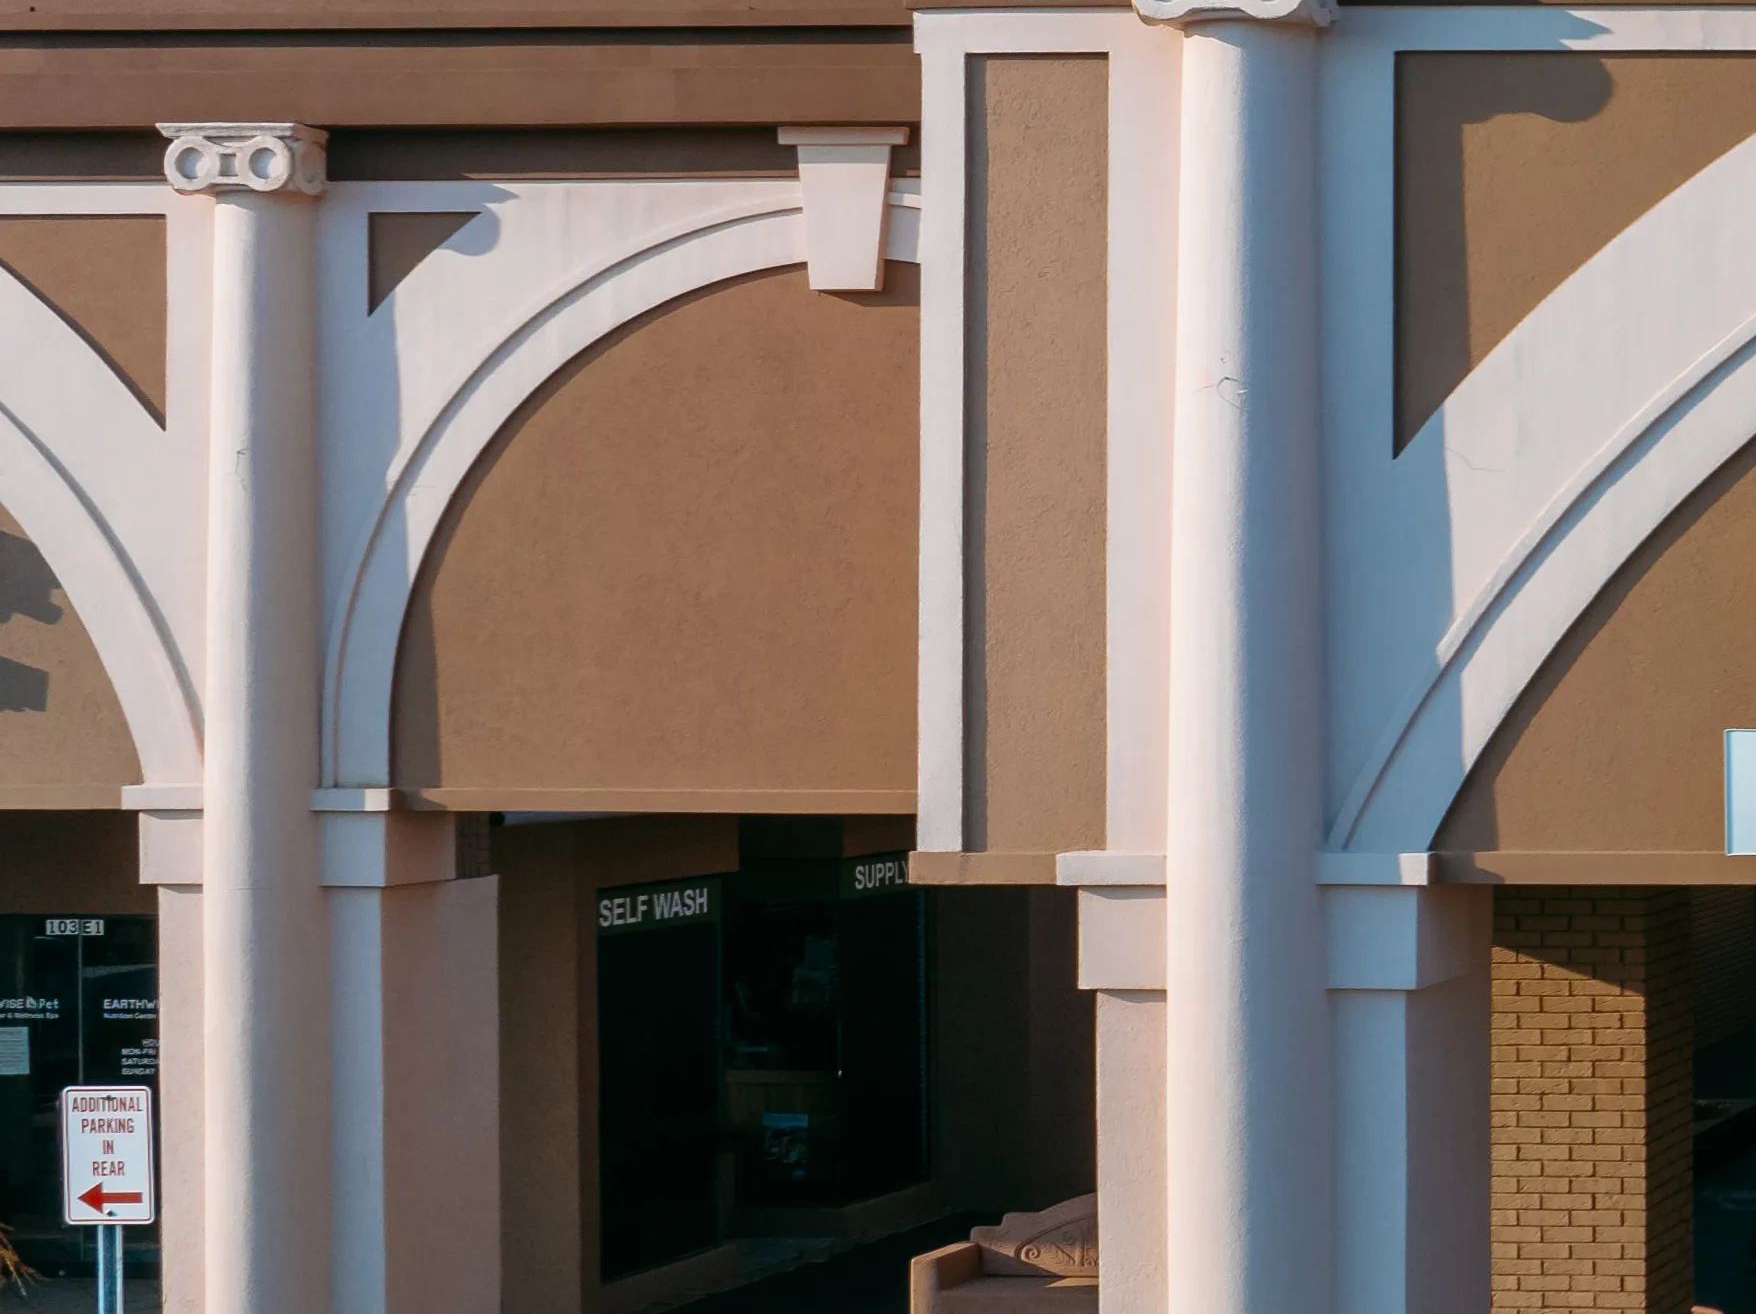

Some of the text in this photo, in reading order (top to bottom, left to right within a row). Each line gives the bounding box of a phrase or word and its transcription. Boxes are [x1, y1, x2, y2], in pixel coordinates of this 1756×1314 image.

[600, 888, 708, 927] SELF WASH
[39, 999, 59, 1009] Pet
[72, 1096, 143, 1112] ADDITIONAL
[81, 1118, 134, 1134] PARKING
[102, 1139, 115, 1154] IN
[92, 1160, 126, 1176] REAR
